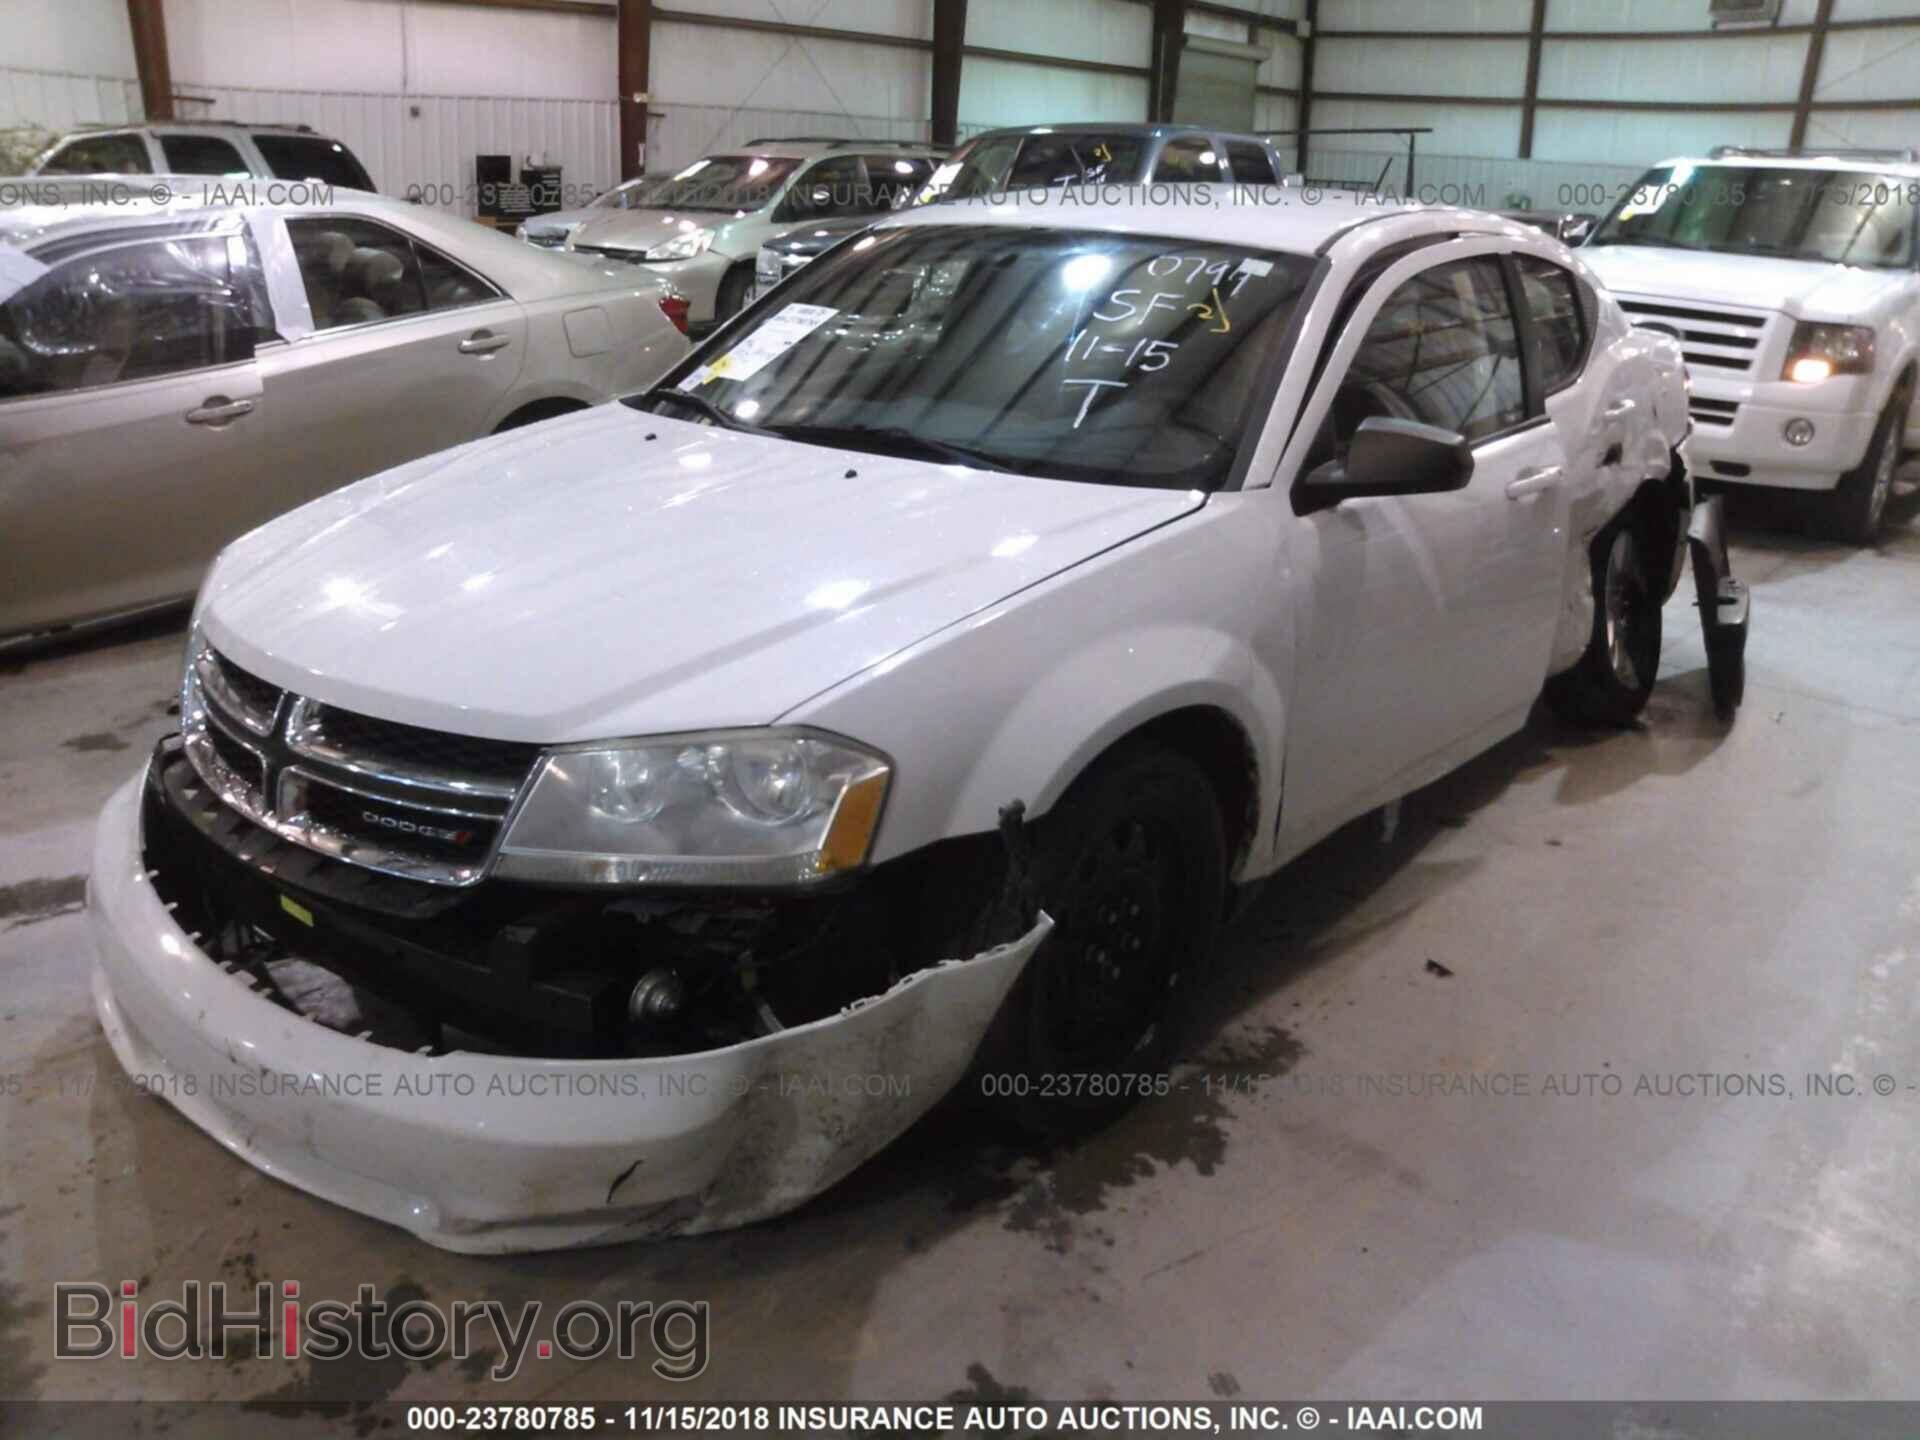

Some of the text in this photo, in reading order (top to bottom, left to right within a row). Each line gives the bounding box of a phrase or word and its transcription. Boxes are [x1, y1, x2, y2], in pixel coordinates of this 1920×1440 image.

[1093, 289, 1184, 325] SF
[1064, 328, 1179, 371] 11-15
[1063, 378, 1128, 428] T
[362, 810, 457, 841] DODGE
